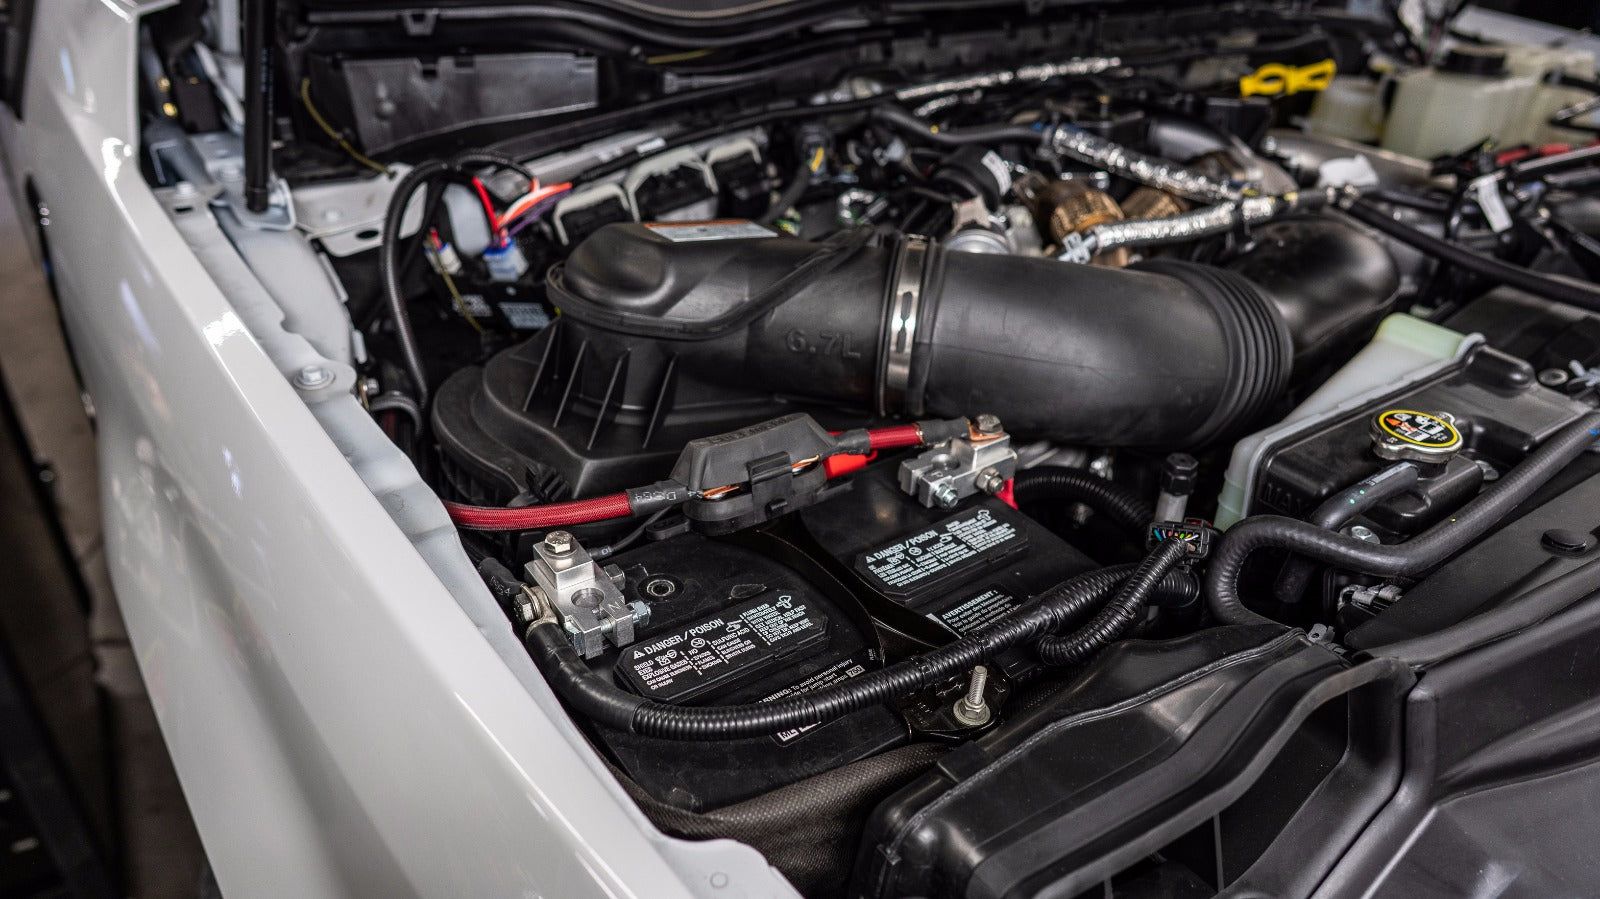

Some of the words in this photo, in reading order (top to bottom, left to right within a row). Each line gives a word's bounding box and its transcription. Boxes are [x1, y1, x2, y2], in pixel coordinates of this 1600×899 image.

[786, 330, 861, 358] 6.7L
[874, 544, 906, 560] DANGER
[910, 530, 938, 546] POISON
[942, 590, 994, 620] AVERTISSEMENT
[644, 635, 684, 655] DANGER
[689, 618, 724, 637] POISON
[634, 660, 654, 670] SHIELD
